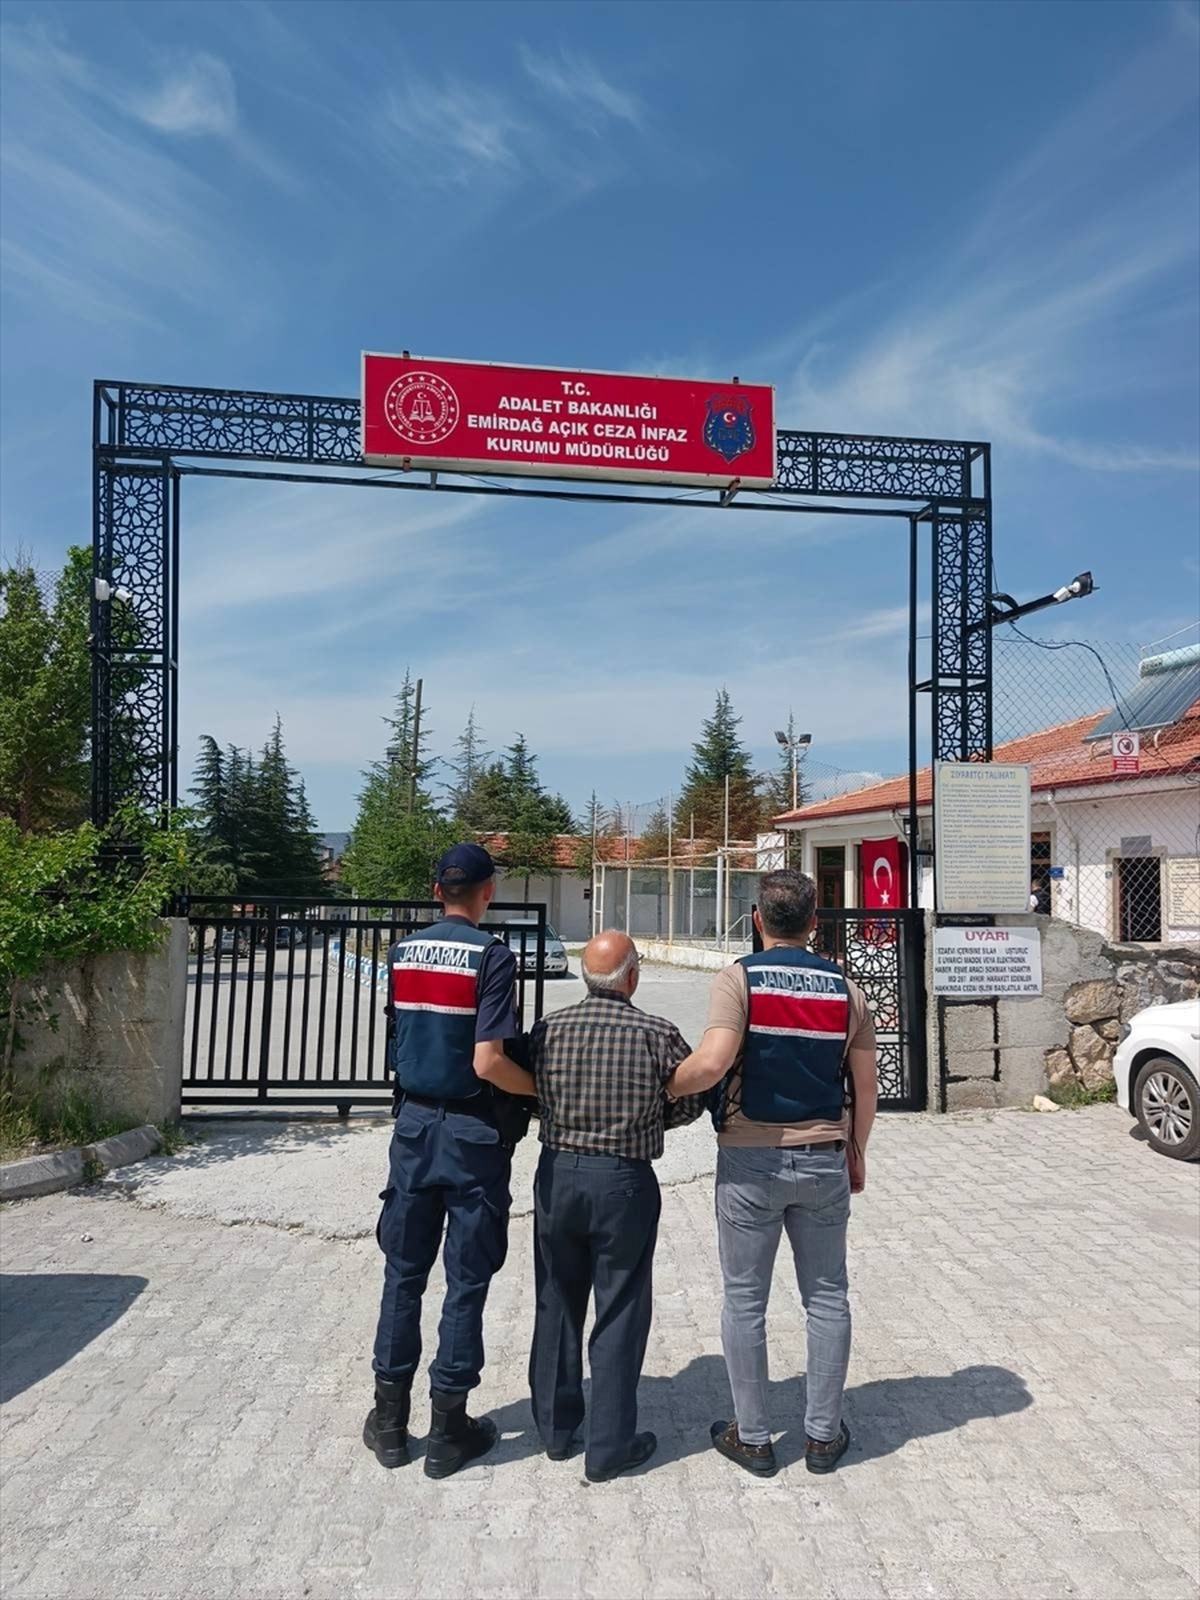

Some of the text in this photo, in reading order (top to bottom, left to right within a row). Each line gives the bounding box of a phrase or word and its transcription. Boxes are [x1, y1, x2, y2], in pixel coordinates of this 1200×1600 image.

[561, 381, 590, 396] T.C.
[498, 396, 657, 420] ADALET BAKANLIĞI
[467, 413, 688, 443] EMİRDAĞ AÇIK CEZA İNFAZ
[486, 437, 669, 462] KURUMU MÜDÜRLÜĞÜ
[965, 931, 1010, 941] UYARI
[399, 945, 470, 968] JANDARMA
[758, 971, 838, 993] JANDARMA
